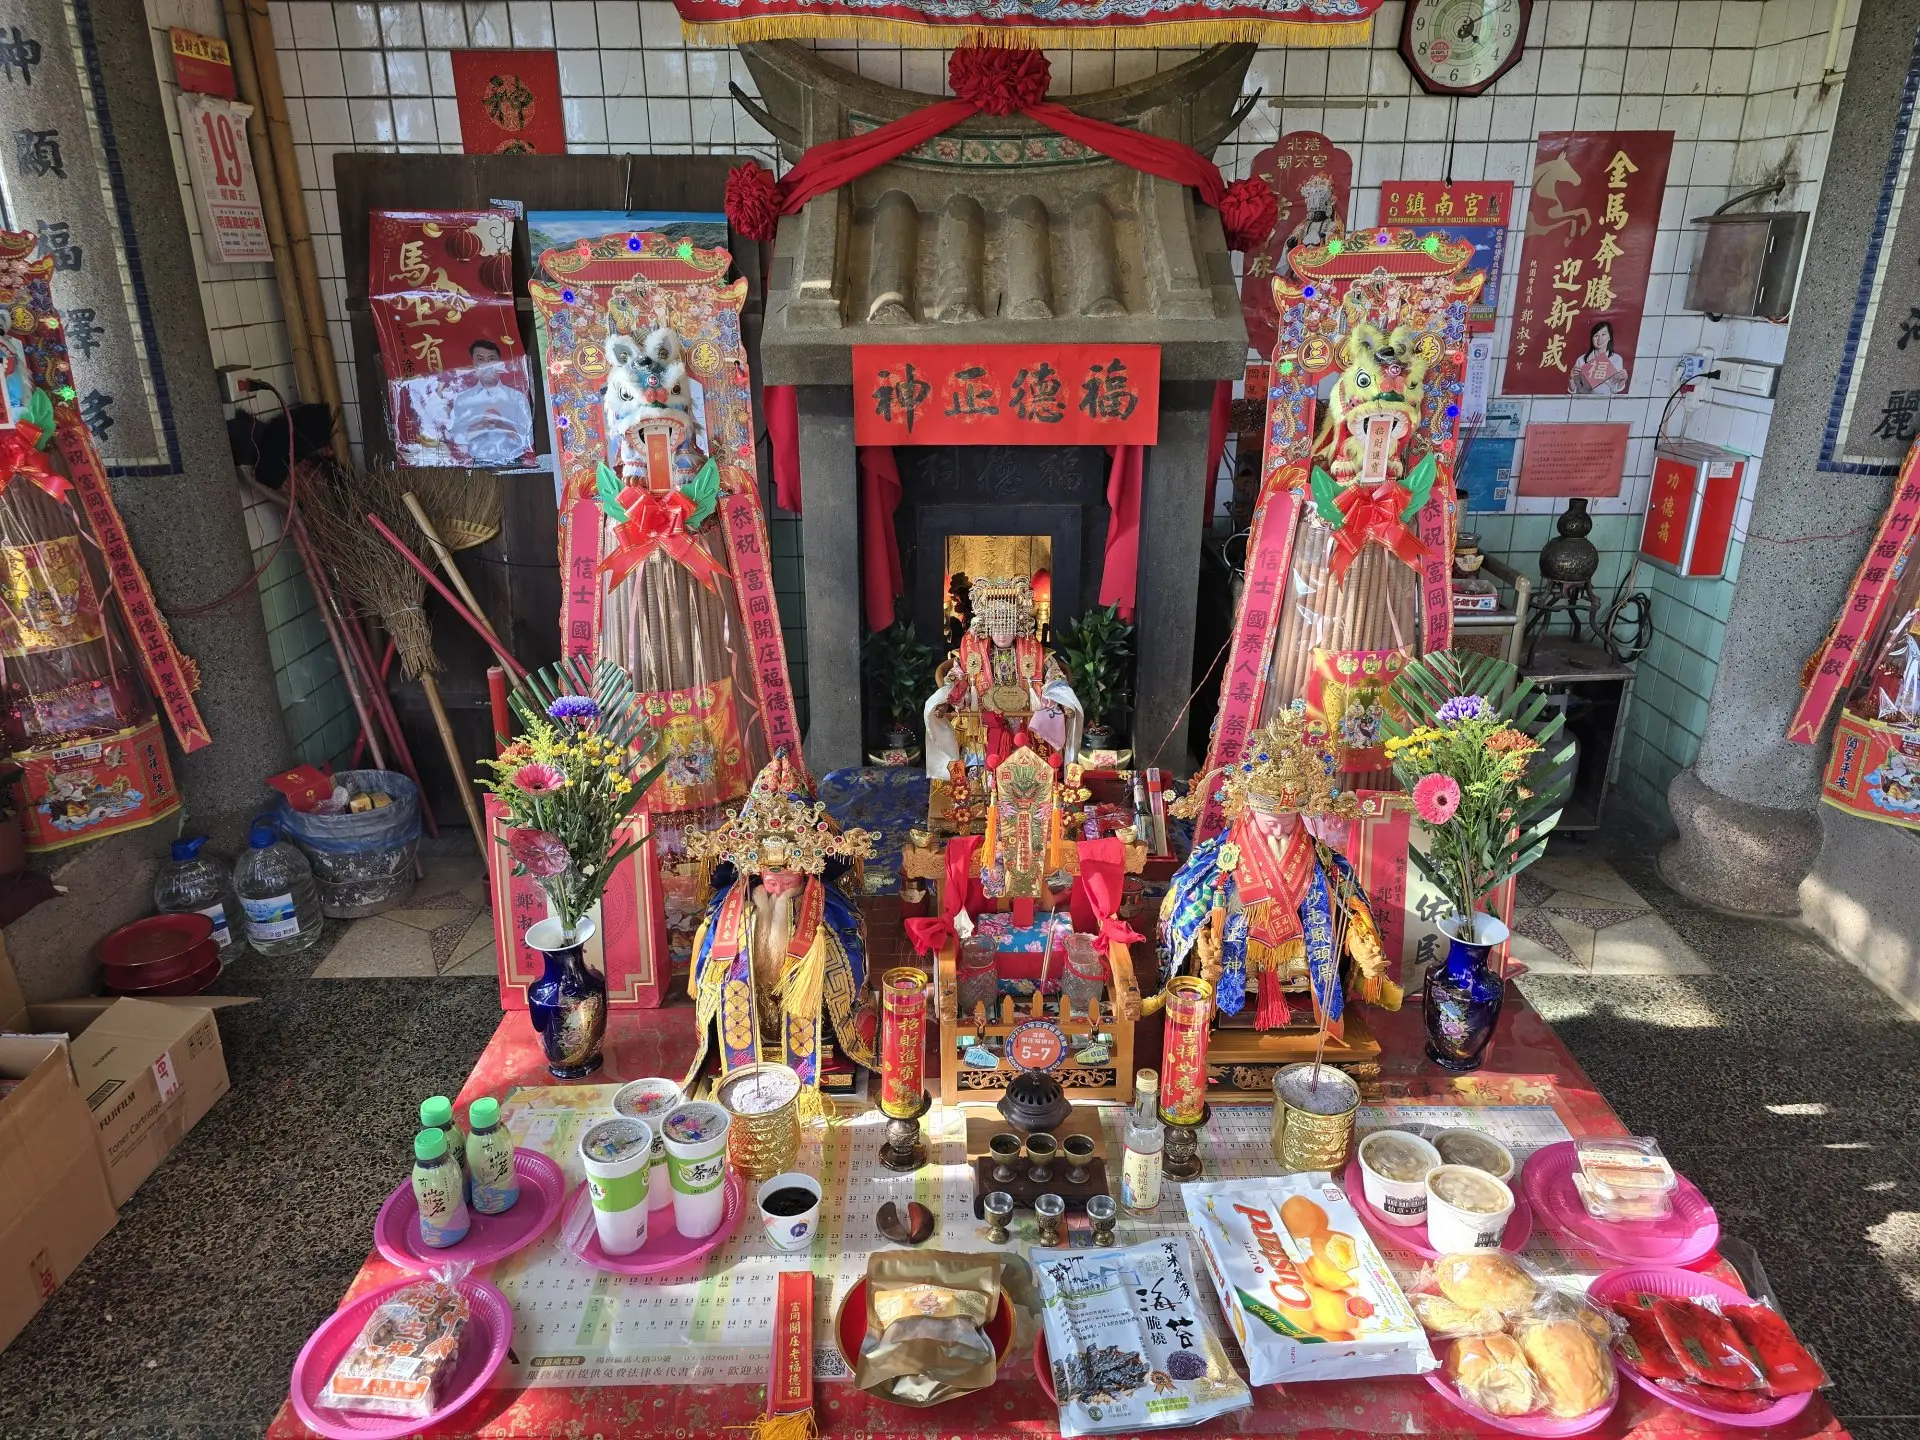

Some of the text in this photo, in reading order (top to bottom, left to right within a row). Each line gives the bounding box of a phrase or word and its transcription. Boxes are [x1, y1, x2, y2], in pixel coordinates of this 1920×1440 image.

[1416, 17, 1425, 31] 9
[1502, 24, 1512, 37] 3
[1418, 42, 1427, 55] 8
[1473, 64, 1482, 76] 5
[1491, 48, 1499, 60] 4
[1450, 69, 1459, 81] 6
[202, 111, 243, 188] 19
[1277, 155, 1328, 168] 朝天宮
[1287, 138, 1321, 151] 北港
[220, 189, 247, 201] 星期五
[1405, 191, 1484, 217] 鎮南宮
[1582, 150, 1639, 312] 金馬奔騰
[1525, 260, 1539, 304] 桃園市議員
[1516, 309, 1534, 355] 鄭淑方
[1539, 257, 1584, 374] 迎新歲
[1305, 340, 1327, 366] 三
[1588, 360, 1608, 380] 福
[732, 505, 760, 554] 恭祝
[1422, 501, 1445, 548] 恭祝
[1657, 472, 1680, 544] 功德箱
[1854, 484, 1920, 612] 新竹福輝宮
[572, 556, 596, 605] 信士
[1253, 548, 1281, 595] 信士
[1819, 634, 1853, 677] 敬獻
[160, 672, 199, 733] 聖誕千秋
[896, 1017, 920, 1081] 招財進寶
[1021, 1046, 1051, 1060] 5-7
[1174, 1029, 1201, 1091] 吉祥如意
[99, 1090, 136, 1131] FUJIFILM
[107, 1132, 129, 1157] Toner
[129, 1101, 162, 1134] Cartridge
[1232, 1203, 1314, 1310] Custard
[1242, 1239, 1260, 1267] LOTTE
[788, 1301, 801, 1398] 富岡開庄老福德祠
